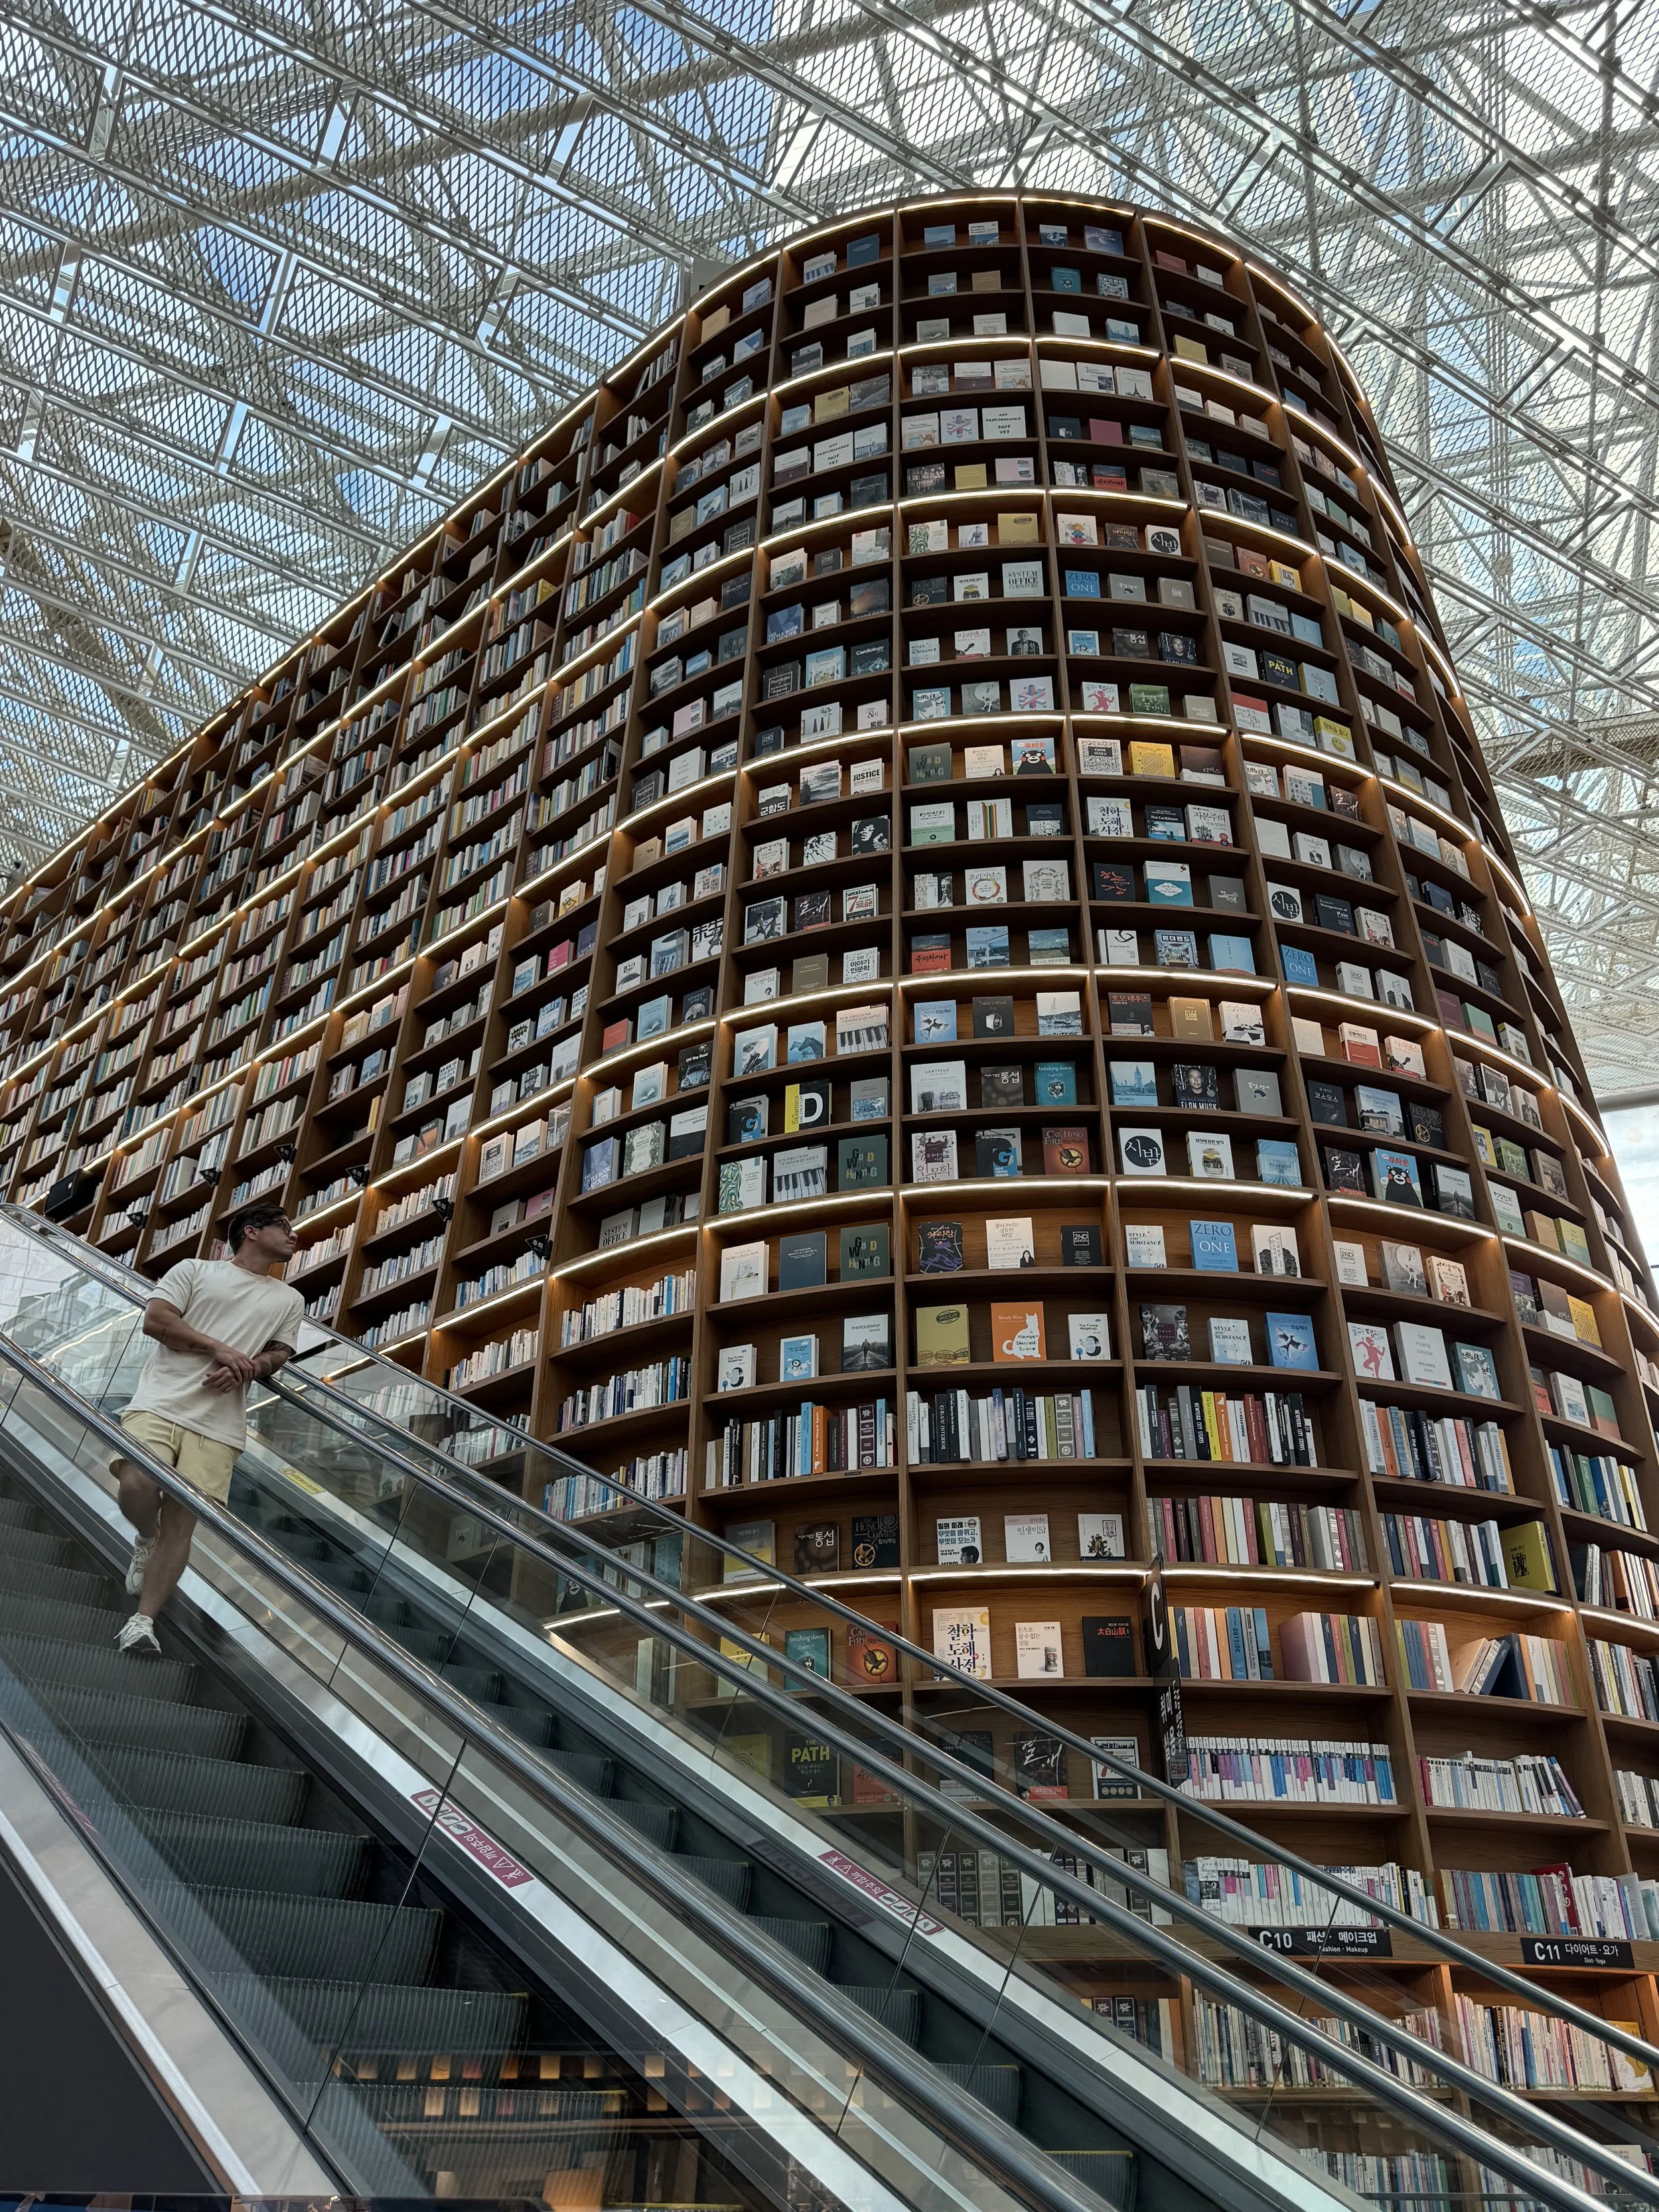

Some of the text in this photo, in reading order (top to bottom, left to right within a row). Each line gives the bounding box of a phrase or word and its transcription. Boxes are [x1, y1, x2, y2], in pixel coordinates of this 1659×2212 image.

[1068, 571, 1097, 581] ZERO
[1072, 583, 1095, 593] ONE
[856, 645, 885, 656] Cardiology
[1269, 661, 1293, 676] PATH
[717, 747, 735, 759] BROWN
[853, 769, 881, 781] JUSTICE
[760, 801, 786, 816] 군함도
[847, 896, 858, 913] 7
[1162, 934, 1190, 942] 원더랜드
[1285, 947, 1313, 963] ZERO
[1289, 963, 1313, 977] ONE
[1001, 1071, 1019, 1084] 통섭
[800, 1092, 824, 1124] D
[1198, 1102, 1217, 1110] MUSK
[1125, 1138, 1161, 1165] 시밤
[846, 1165, 877, 1180] HUNTING
[603, 1222, 628, 1236] SYSTEM
[927, 1230, 954, 1239] 아리랑
[1194, 1223, 1232, 1236] ZERO
[532, 1239, 543, 1249] 주의
[602, 1230, 628, 1247] OFFICE
[1199, 1240, 1230, 1254] ONE
[849, 1255, 881, 1270] HUNTING
[1017, 1524, 1046, 1535] 인생미답
[814, 1529, 834, 1548] 통섭
[1151, 1583, 1163, 1651] C
[789, 1634, 810, 1643] breaking
[948, 1623, 977, 1641] 철학
[1232, 1628, 1241, 1653] OUTSIDE
[948, 1641, 975, 1657] 도해
[949, 1657, 977, 1673] 사전
[792, 1746, 830, 1763] PATH
[851, 1871, 884, 1895] 끼임주의
[1259, 1931, 1292, 1949] C10
[1306, 1931, 1377, 1944] 패션 메이크업
[1534, 1942, 1560, 1960] C11
